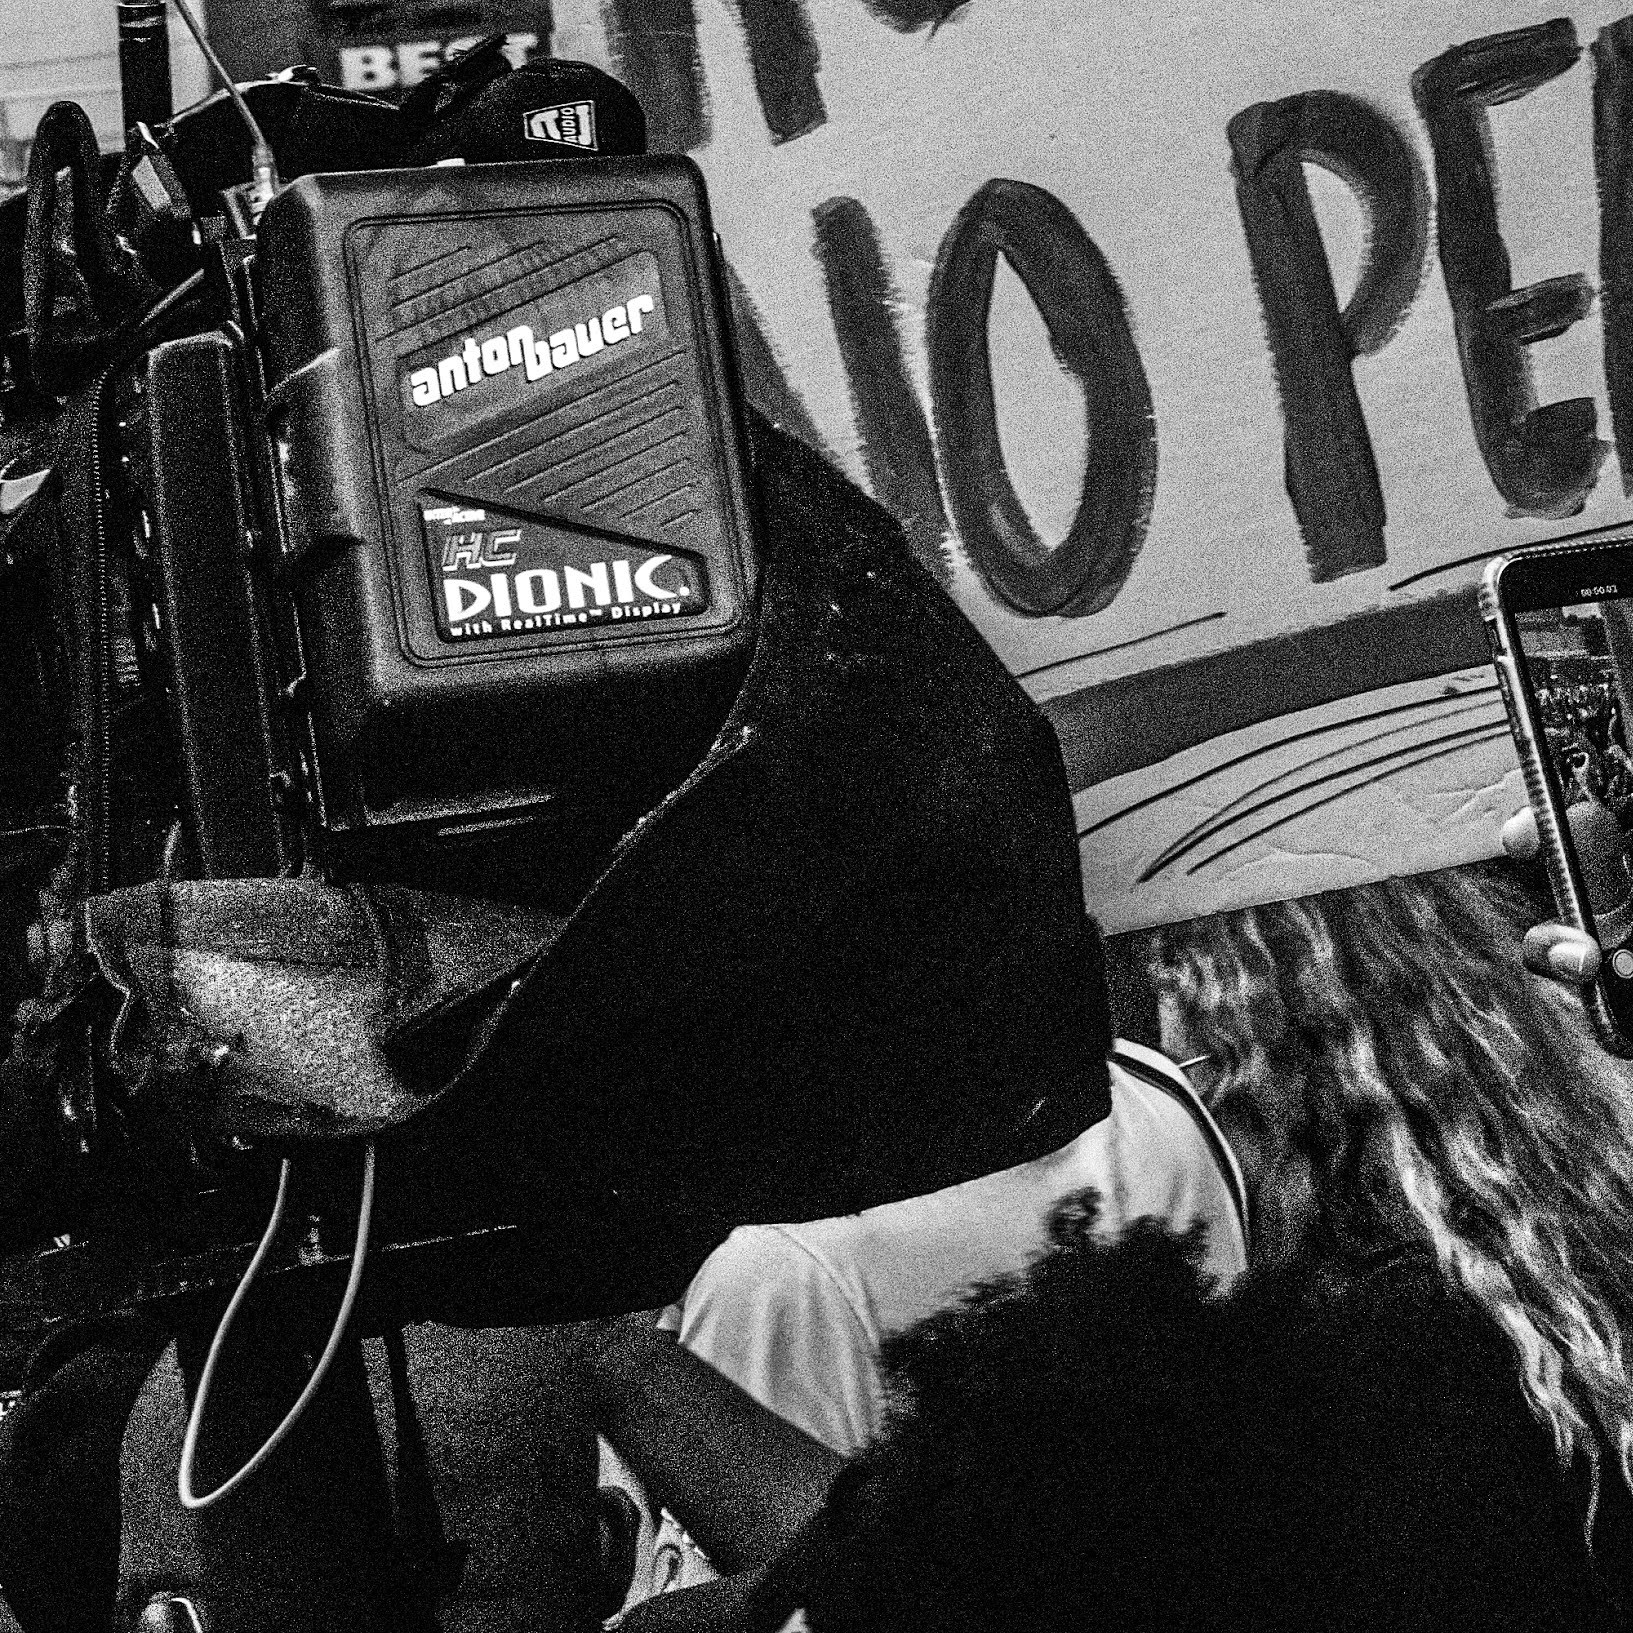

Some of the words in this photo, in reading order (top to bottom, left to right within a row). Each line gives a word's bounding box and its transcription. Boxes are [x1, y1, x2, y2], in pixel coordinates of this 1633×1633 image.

[560, 106, 579, 144] AUDIO
[442, 529, 522, 571] HC
[449, 620, 493, 637] with
[611, 601, 682, 620] Display
